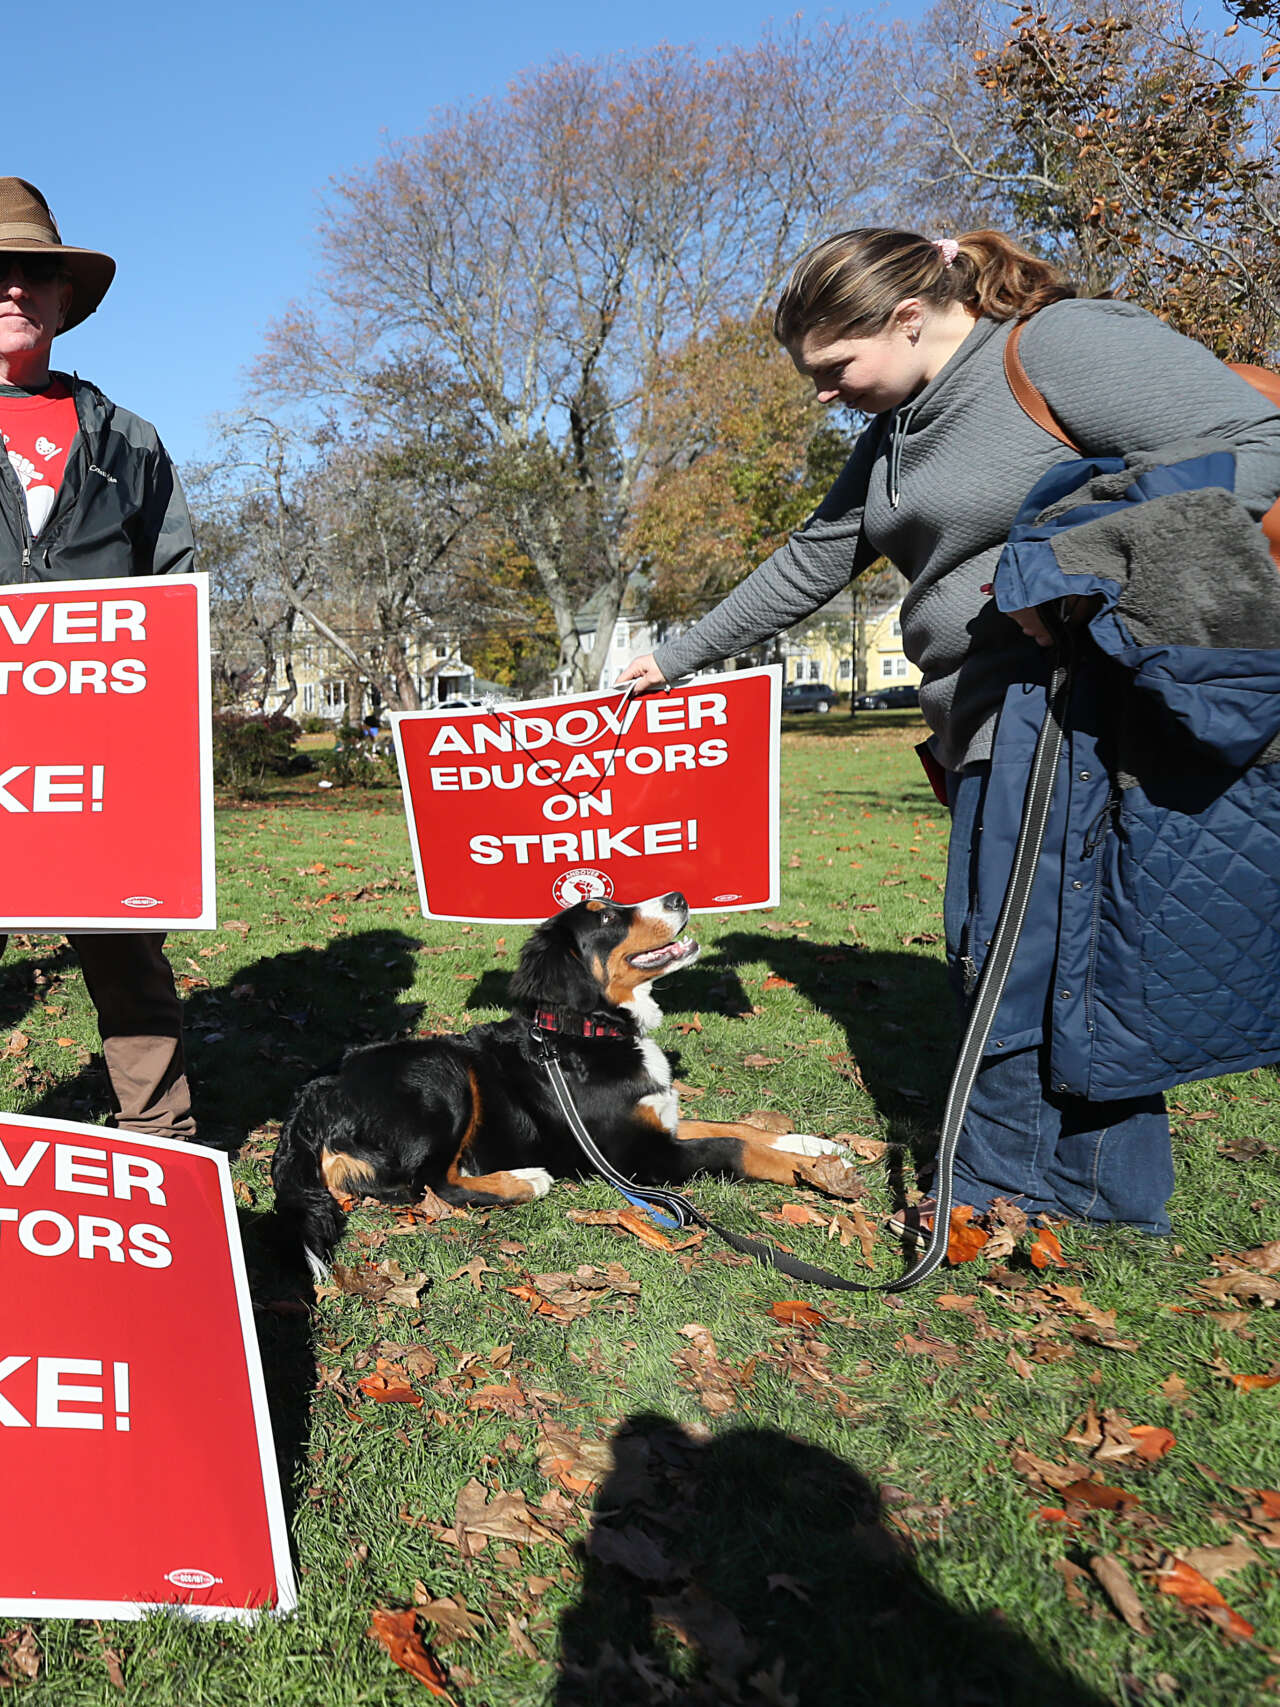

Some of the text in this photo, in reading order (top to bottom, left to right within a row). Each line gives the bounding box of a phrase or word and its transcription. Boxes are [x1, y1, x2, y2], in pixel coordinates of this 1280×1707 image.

[428, 693, 727, 756] ANDOVER
[430, 739, 728, 791] EDUCATORS
[543, 790, 613, 822] ON
[470, 819, 697, 865] STRIKE!
